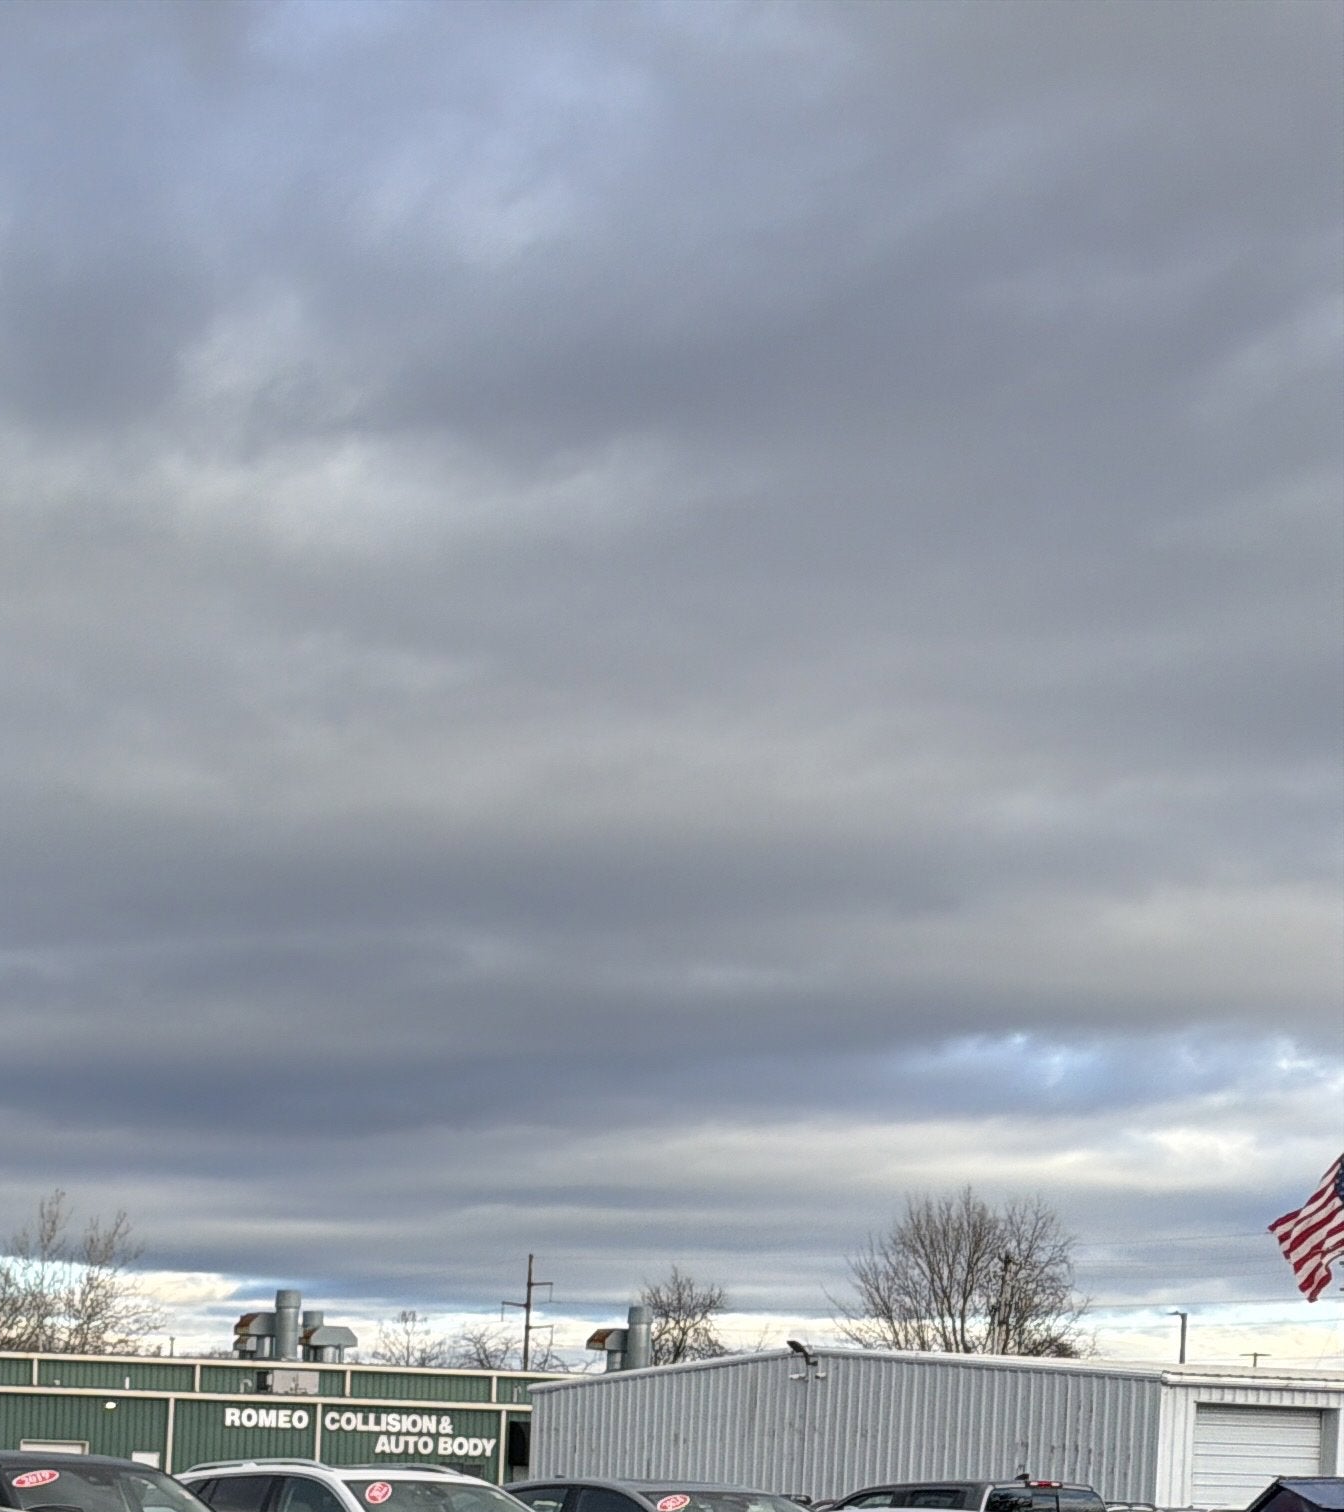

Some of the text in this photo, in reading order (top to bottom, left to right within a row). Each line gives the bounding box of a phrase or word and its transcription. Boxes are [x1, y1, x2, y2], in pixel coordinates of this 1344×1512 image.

[224, 1407, 454, 1435] ROMEO COLLISION &
[374, 1434, 496, 1457] AUTO BODY
